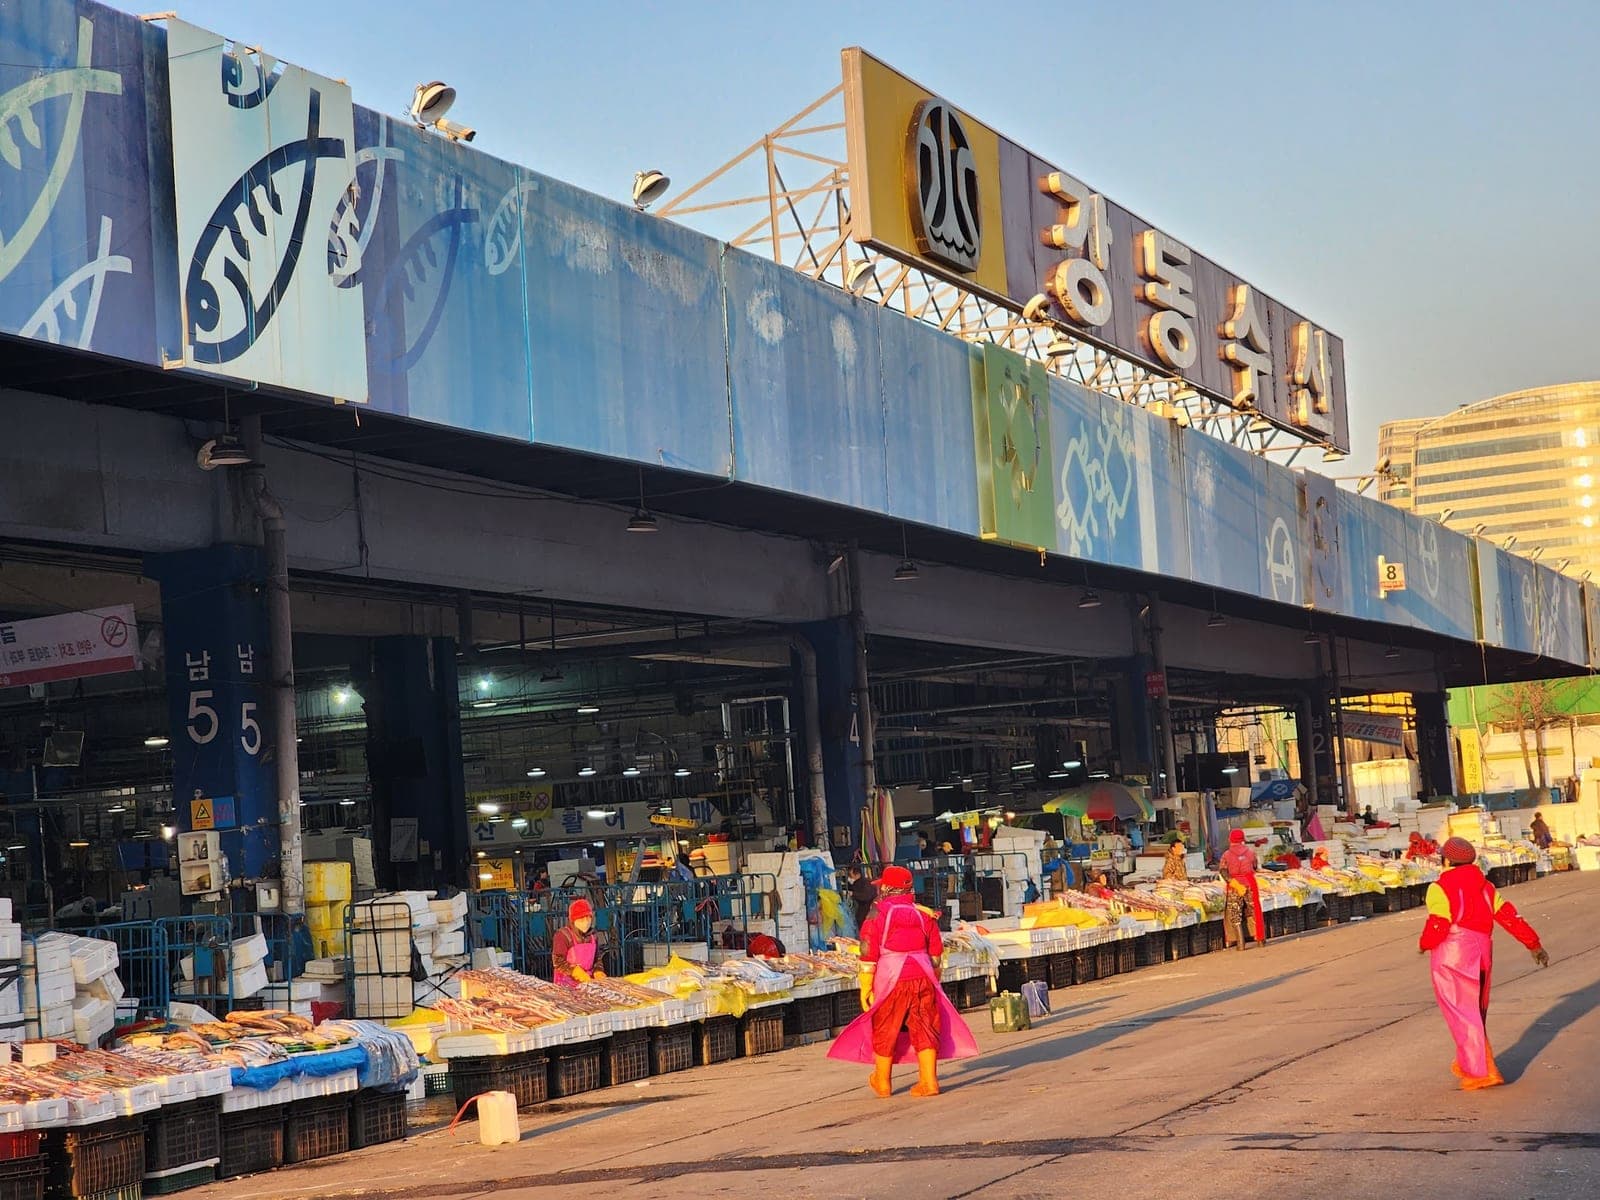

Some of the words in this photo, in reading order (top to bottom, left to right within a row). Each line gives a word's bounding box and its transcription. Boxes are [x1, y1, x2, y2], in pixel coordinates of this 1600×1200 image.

[1040, 171, 1335, 437] 강동수산
[1386, 565, 1397, 580] 8
[186, 650, 210, 681] 남
[237, 643, 253, 674] 남
[187, 690, 218, 743] 5
[240, 702, 261, 755] 5
[849, 712, 860, 748] 4
[1312, 733, 1326, 754] 2
